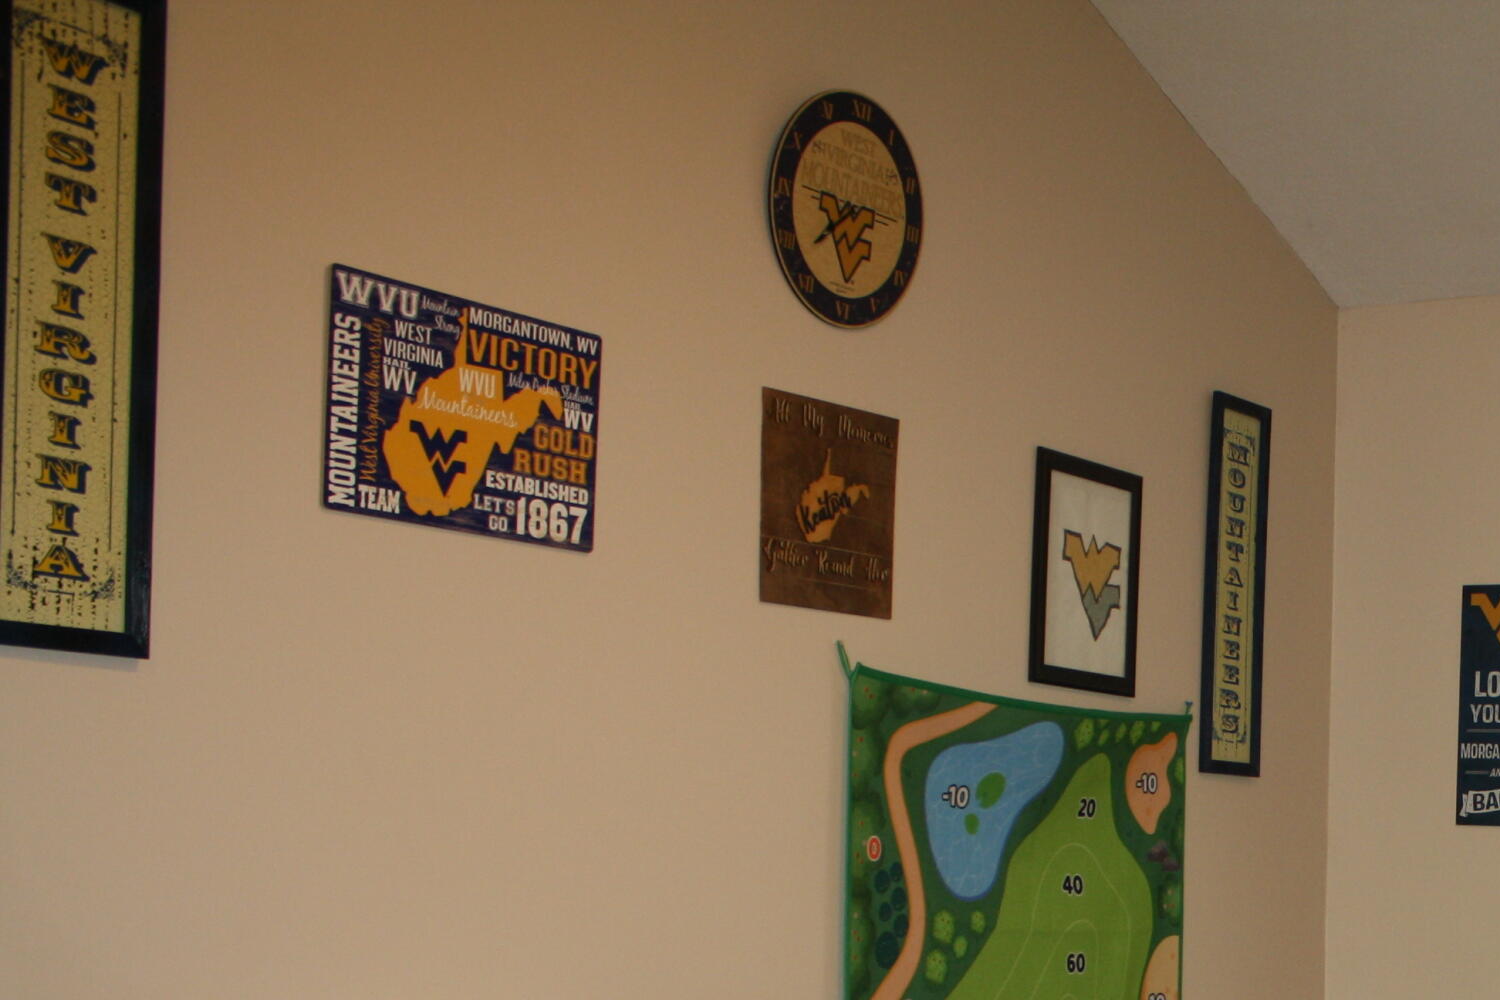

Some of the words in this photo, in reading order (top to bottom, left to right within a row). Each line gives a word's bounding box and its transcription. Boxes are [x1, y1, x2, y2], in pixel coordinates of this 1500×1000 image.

[37, 33, 110, 217] WEST
[335, 270, 420, 319] WVU
[395, 320, 432, 345] WEST
[576, 336, 598, 356] WV
[383, 337, 444, 369] VIRGINIA
[383, 356, 411, 370] HAIL
[468, 329, 598, 389] VICTORY
[383, 367, 417, 395] WV
[458, 367, 497, 399] WVU
[33, 231, 98, 584] VIRGINIA
[328, 312, 362, 508] MOUNTAINEERS
[361, 390, 386, 444] Virginia
[417, 386, 519, 429] Mountaineers
[564, 410, 593, 433] WV
[533, 423, 593, 460] GOLD
[359, 445, 378, 482] West
[514, 448, 588, 485] RUSH
[358, 485, 400, 514] TEAM
[485, 470, 589, 506] ESTABLISHED
[516, 497, 588, 544] 1867
[1220, 441, 1251, 736] MOUNTAINEERS
[942, 784, 969, 809] -10
[1136, 773, 1158, 794] -10
[1078, 799, 1096, 818] 20
[1063, 875, 1083, 895] 40
[1067, 954, 1085, 973] 60
